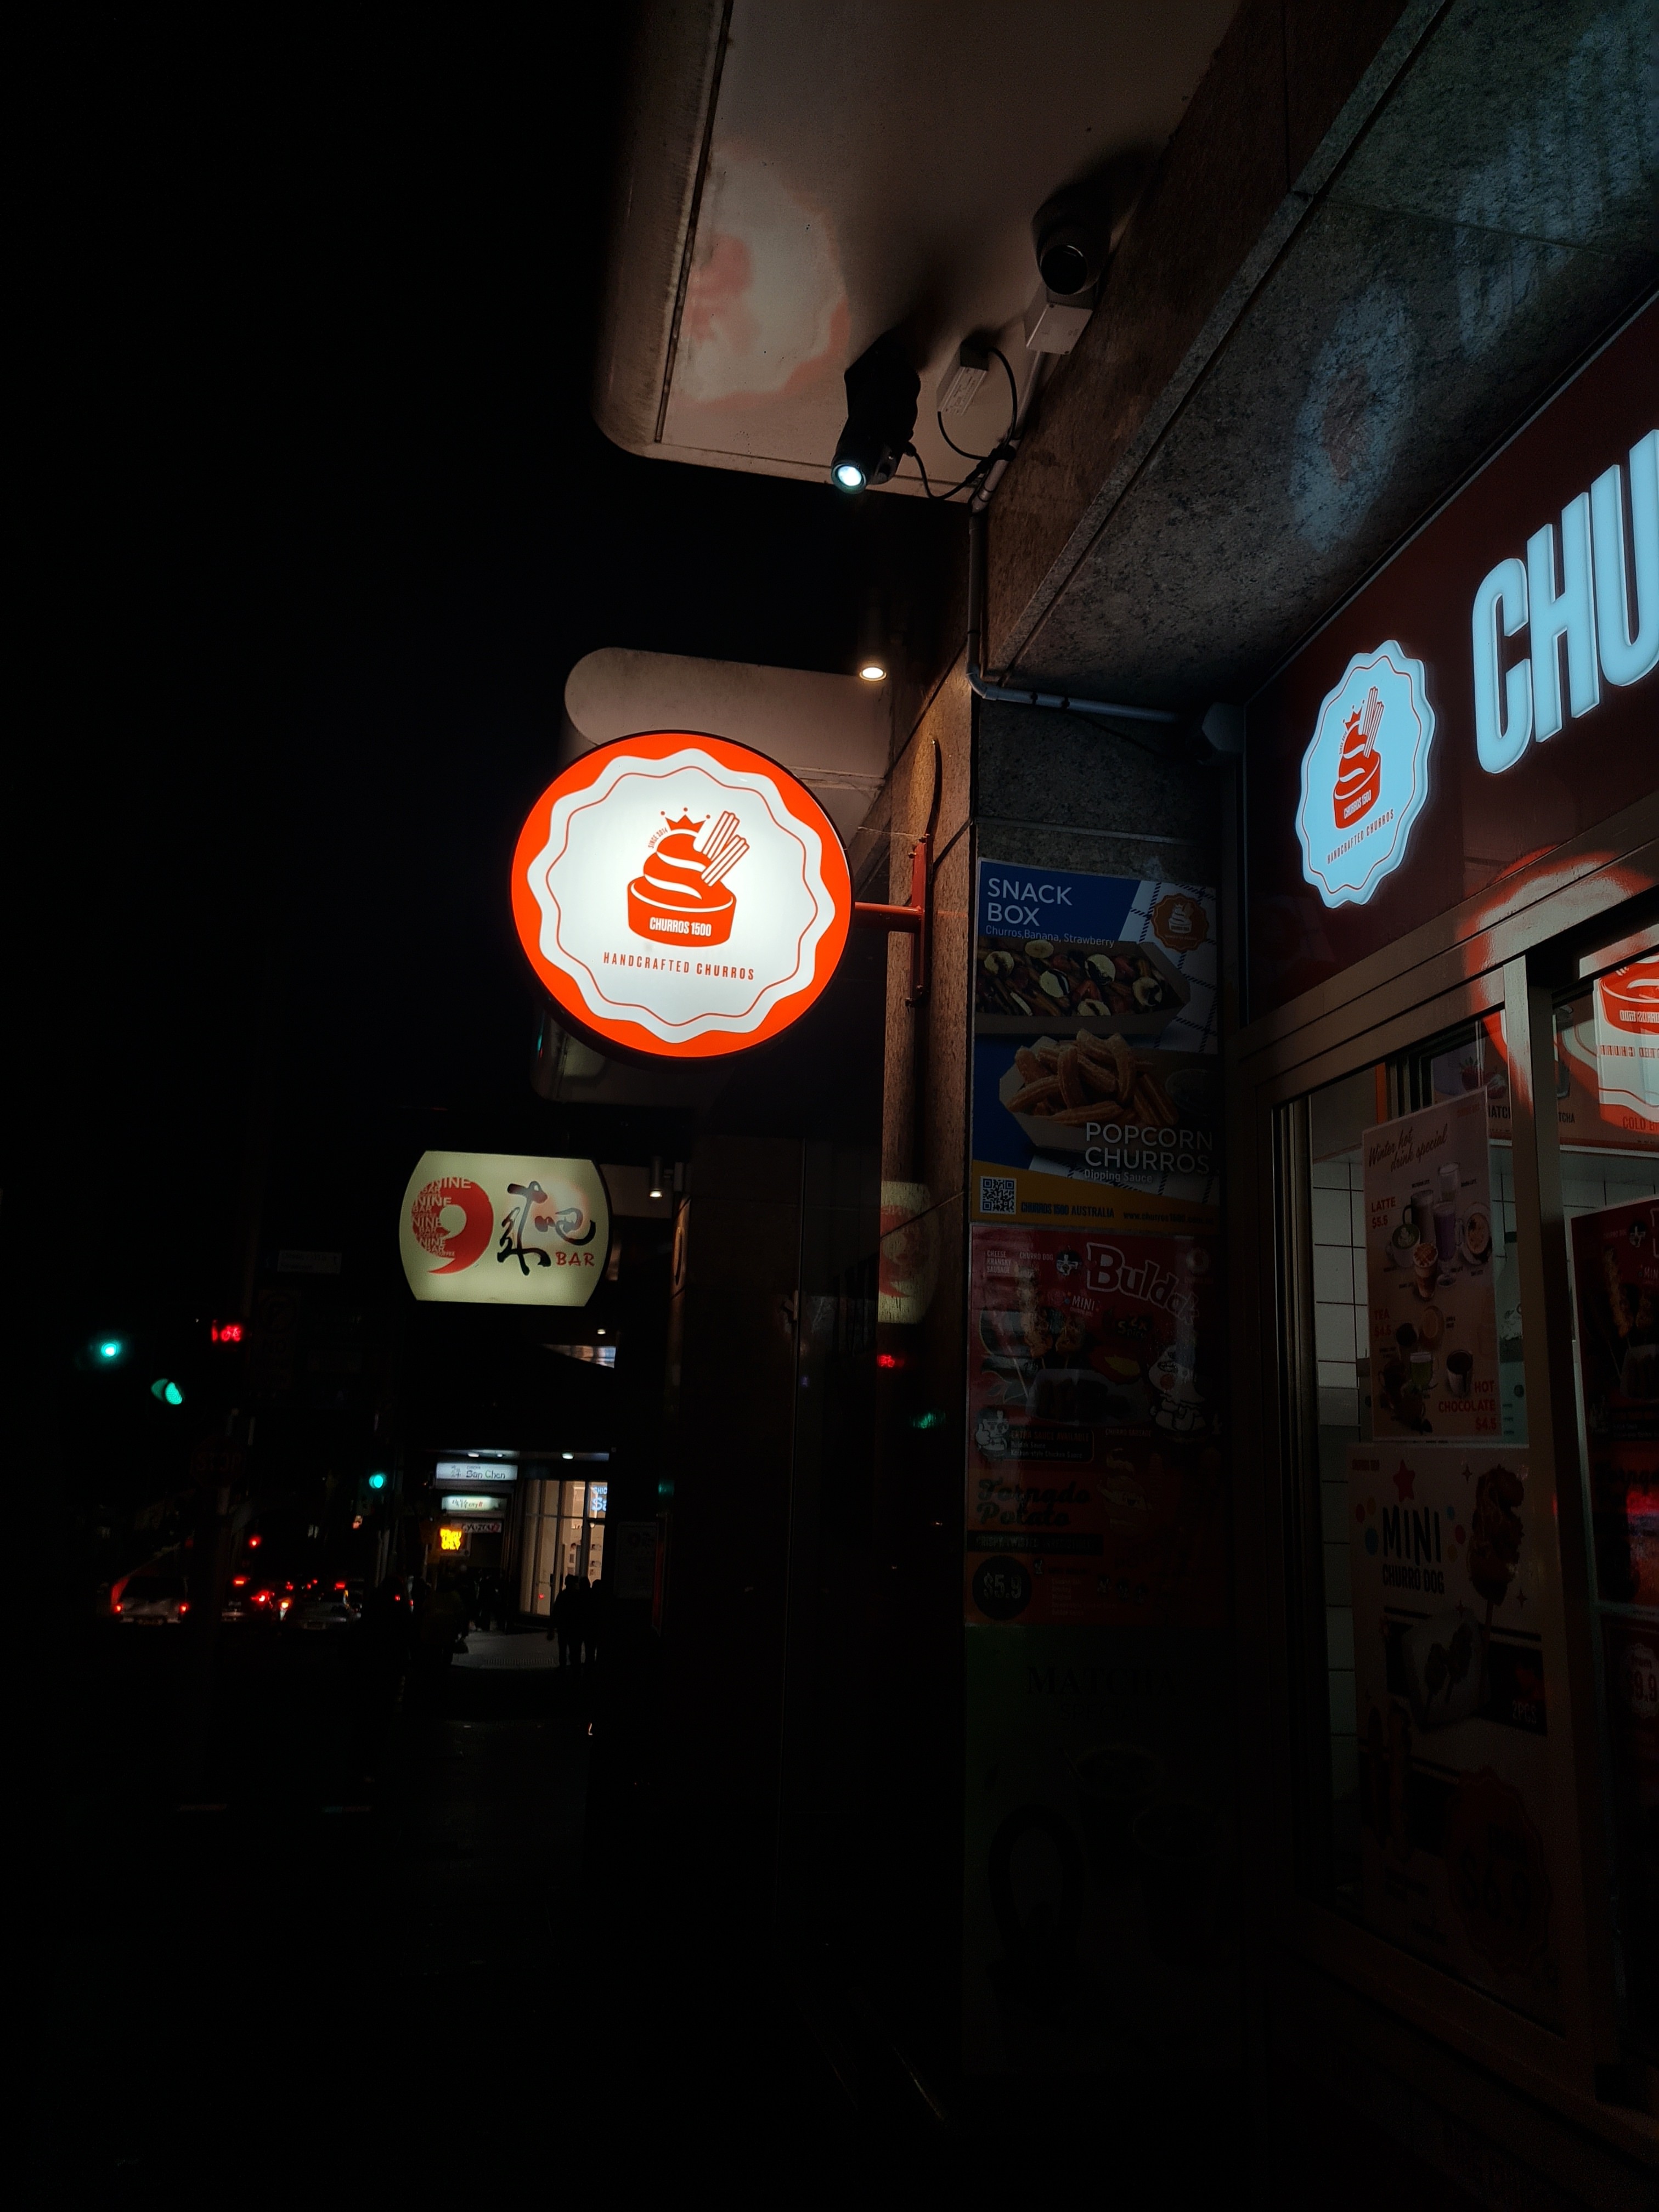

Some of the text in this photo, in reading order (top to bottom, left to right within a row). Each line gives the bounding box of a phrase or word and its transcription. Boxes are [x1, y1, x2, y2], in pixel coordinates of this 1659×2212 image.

[1472, 429, 1659, 774] CHU
[1344, 797, 1361, 819] CHURROS
[1327, 808, 1394, 864] HANDCRAFTED CHURROS
[987, 878, 1073, 906] SNACK
[988, 904, 1040, 926] BOX
[650, 916, 712, 937] CHURROS 1500
[1063, 931, 1114, 949] Strawberry
[603, 952, 754, 980] HANDCRAFTED CHURROS
[1623, 1116, 1646, 1130] COLD
[1085, 1121, 1214, 1151] POPCORN
[1369, 1126, 1414, 1167] Winter hot
[1390, 1123, 1448, 1172] drink special
[1085, 1146, 1210, 1175] CHURROS
[1084, 1168, 1153, 1184] Dipping Sauce
[1021, 1202, 1052, 1214] CHURROS
[1071, 1205, 1114, 1218] AUSTRALIA
[1371, 1197, 1396, 1212] LATTE
[1372, 1215, 1388, 1229] $5.5
[556, 1251, 595, 1267] BAR
[1042, 1253, 1054, 1261] DOG
[1071, 1295, 1095, 1311] MINI
[1374, 1308, 1390, 1321] TEA
[1474, 1380, 1495, 1394] HOT
[1438, 1398, 1496, 1414] CHOCOLATE
[466, 1470, 483, 1479] San
[978, 1479, 1091, 1506] Tornado
[977, 1502, 1072, 1527] Potato
[1383, 1505, 1442, 1565] MINI
[983, 1571, 1023, 1599] $5.9
[1382, 1564, 1444, 1594] CHURRO DOG
[1511, 1699, 1537, 1725] 2PCS
[1459, 1845, 1531, 1931] $6.9
